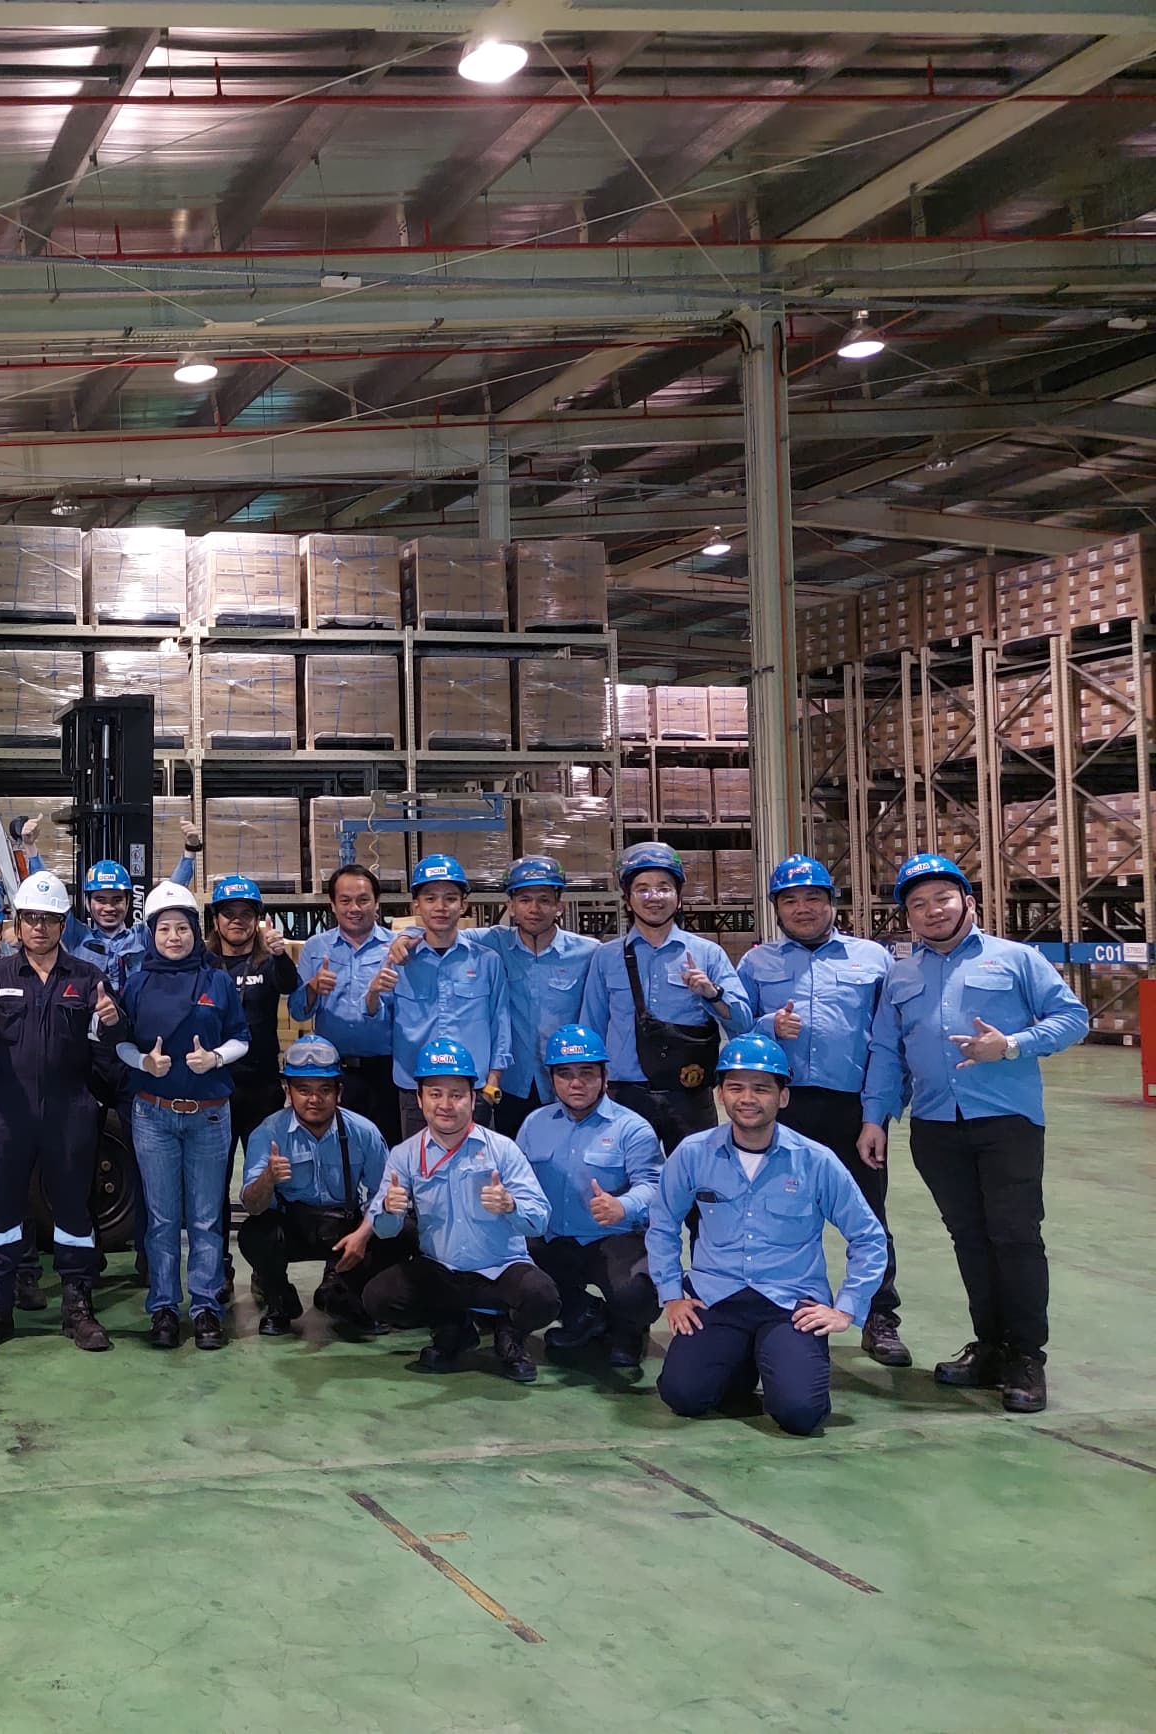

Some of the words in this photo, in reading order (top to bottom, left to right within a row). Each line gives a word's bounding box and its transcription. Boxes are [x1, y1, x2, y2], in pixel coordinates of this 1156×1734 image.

[906, 864, 930, 875] OCIM
[1095, 945, 1121, 961] C01
[562, 1046, 584, 1054] OCIM
